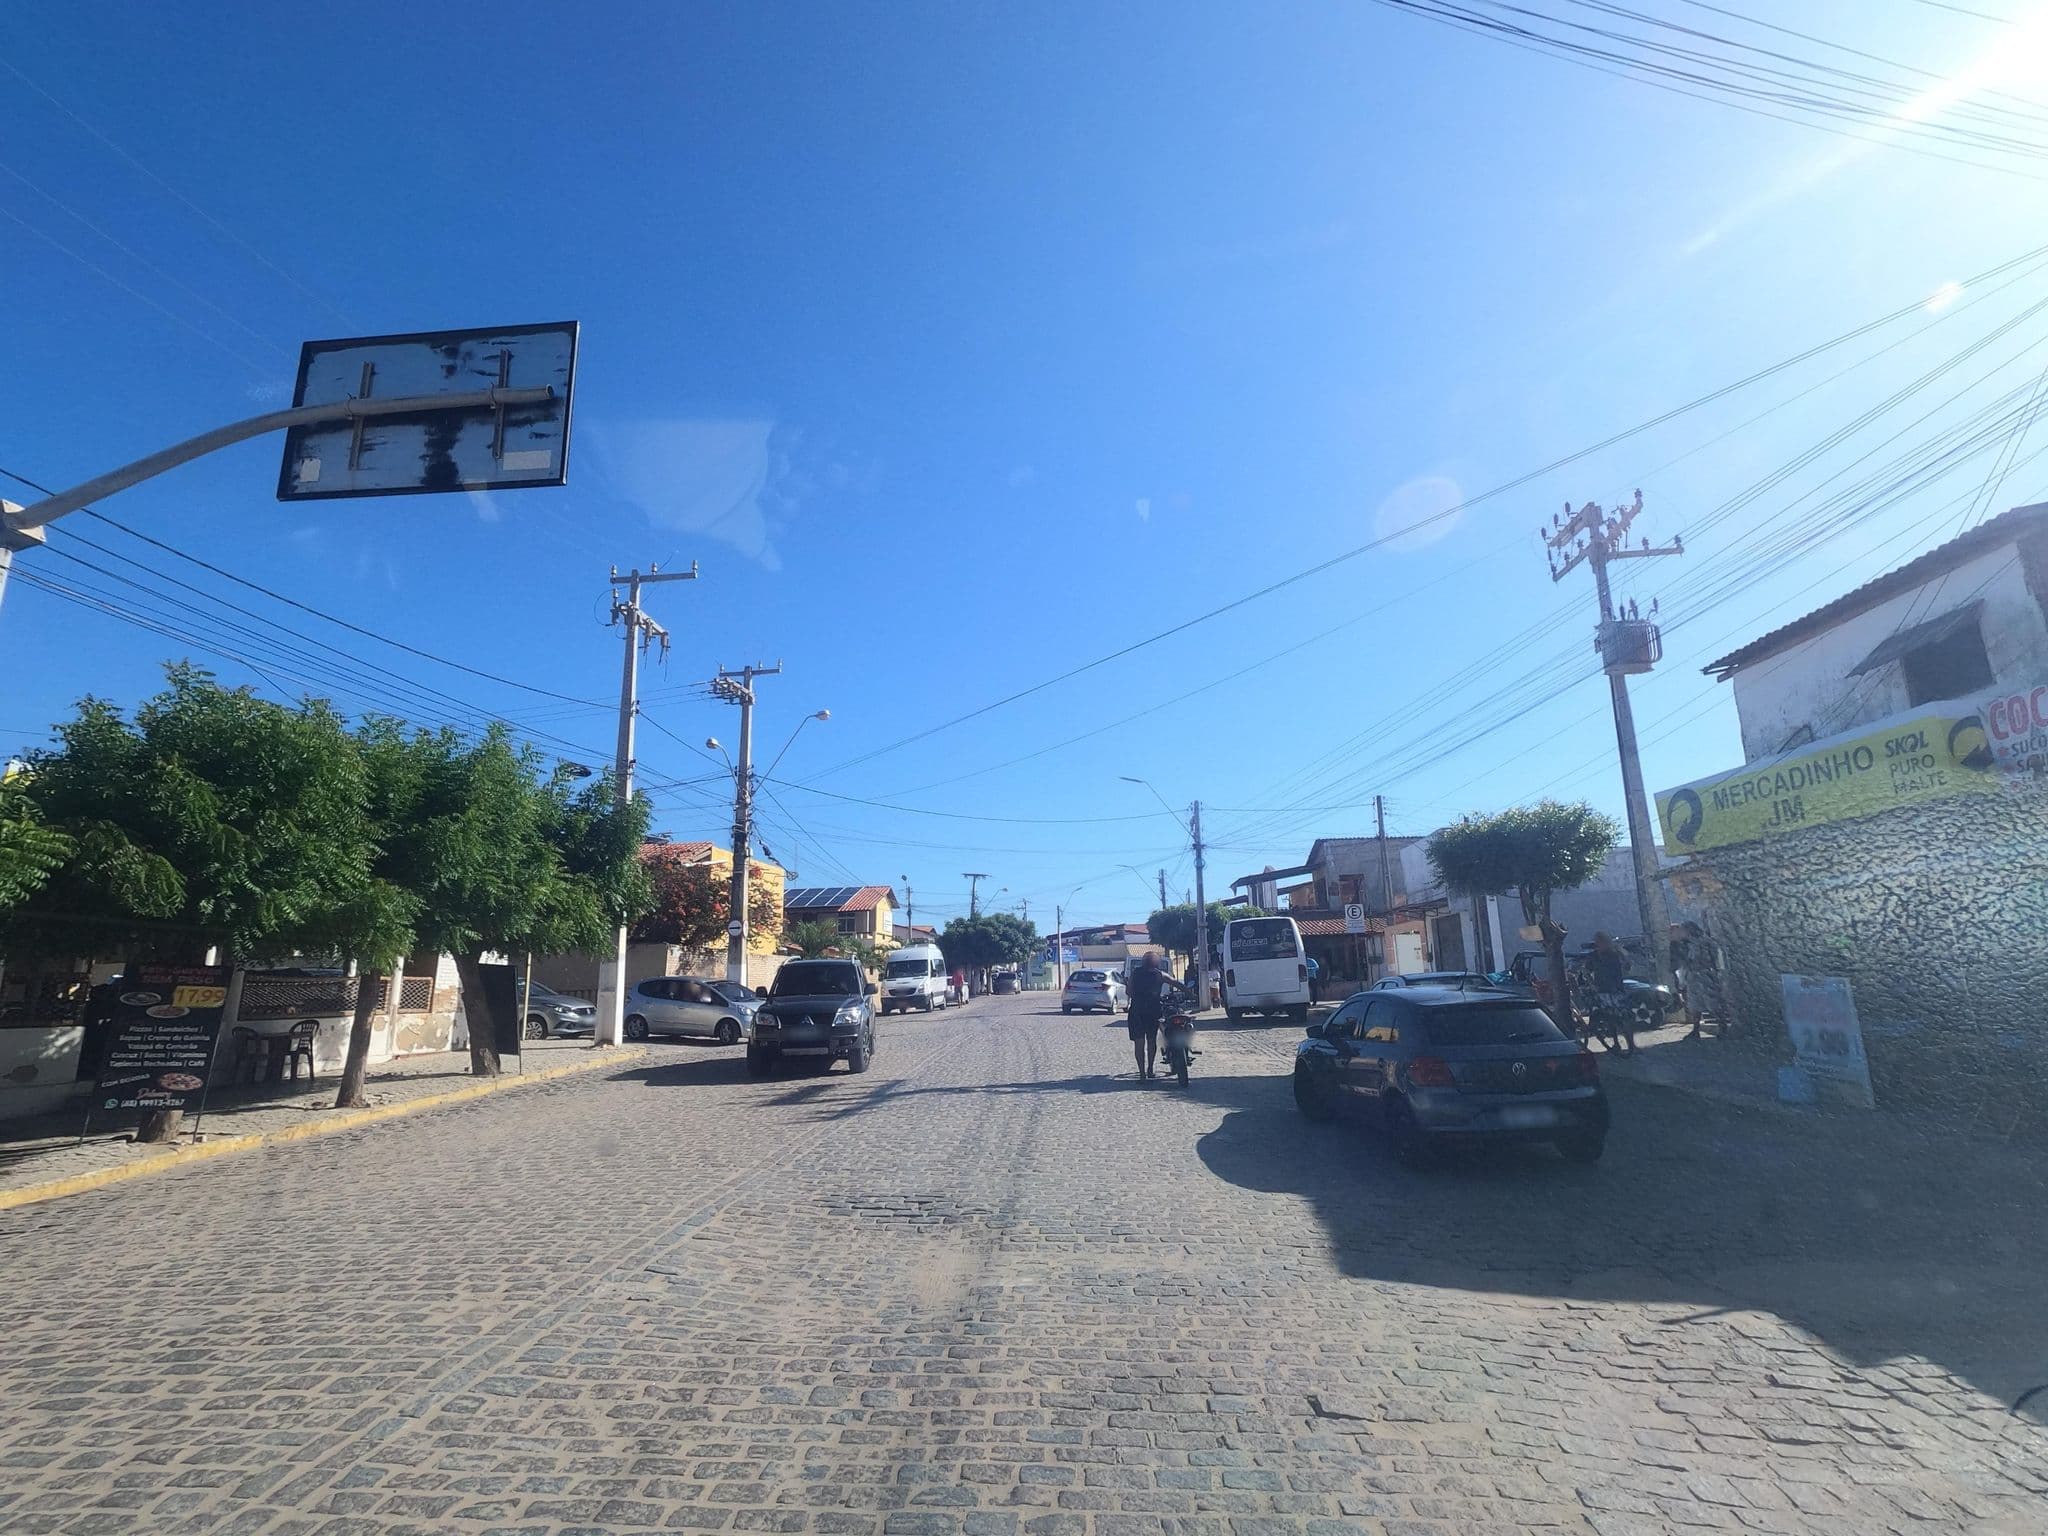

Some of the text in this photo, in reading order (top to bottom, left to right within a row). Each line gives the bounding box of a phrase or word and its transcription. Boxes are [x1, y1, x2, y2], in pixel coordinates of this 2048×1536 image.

[1884, 730, 1929, 758] SKOL
[1712, 745, 1875, 811] MERCADINHO
[1890, 753, 1936, 778] PURO
[1893, 770, 1948, 794] MALTE
[1768, 795, 1805, 827] JM
[1352, 908, 1358, 917] E
[176, 988, 225, 1003] 17,99
